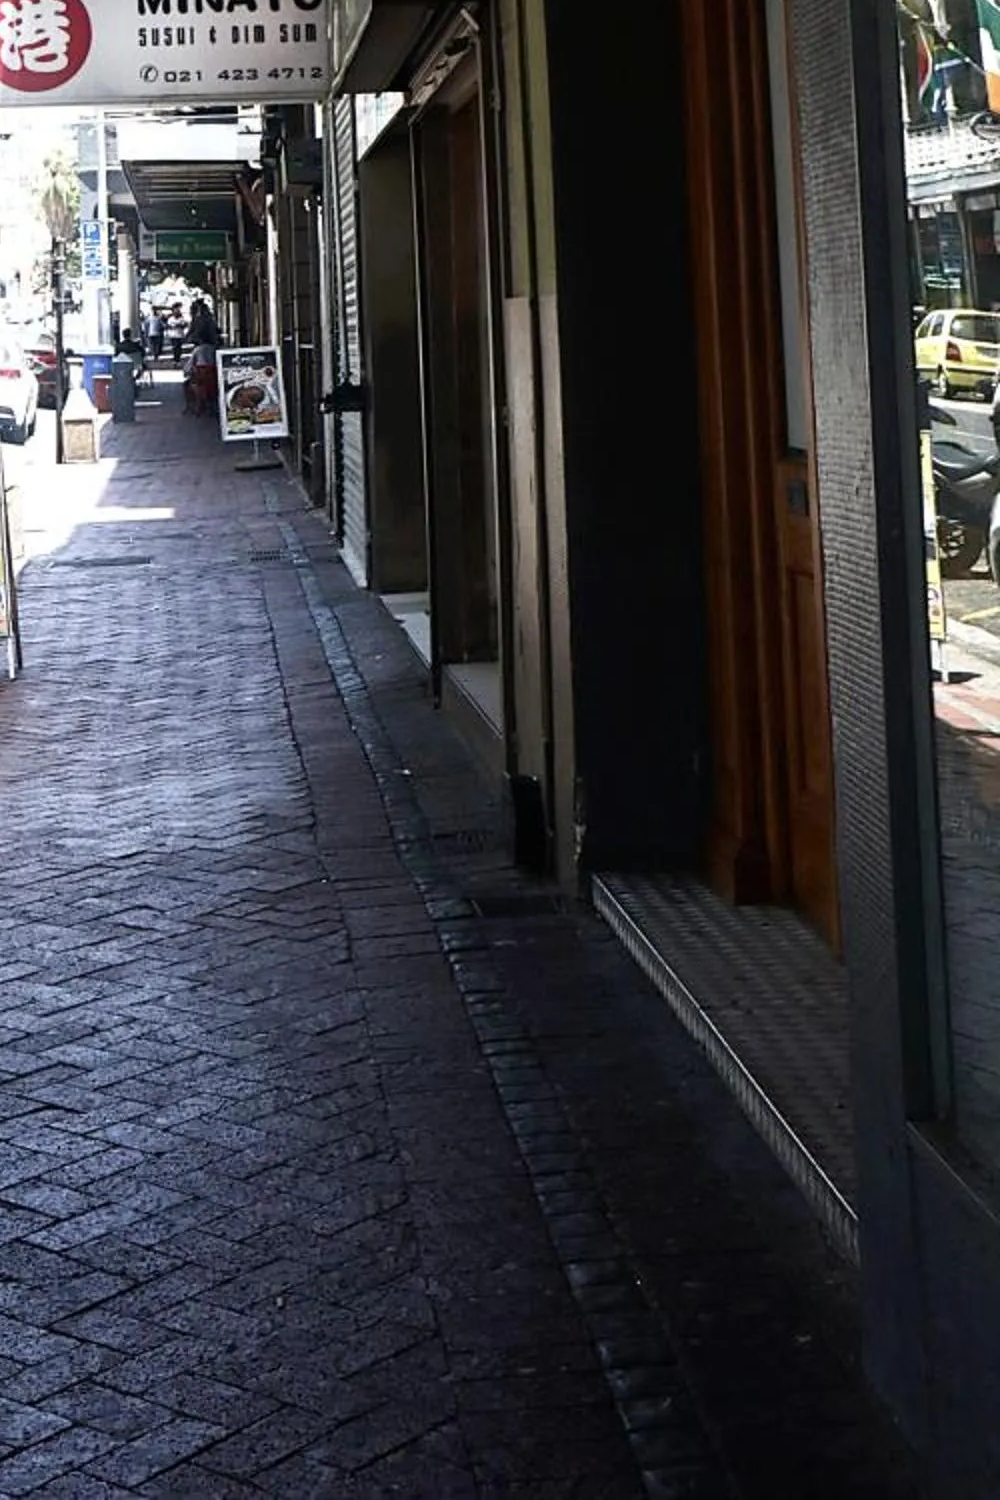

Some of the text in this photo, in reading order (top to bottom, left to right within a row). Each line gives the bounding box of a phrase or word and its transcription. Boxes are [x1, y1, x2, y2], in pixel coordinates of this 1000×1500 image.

[138, 25, 195, 47] SUSHI
[231, 24, 265, 44] DIM
[279, 23, 318, 43] SUM
[164, 66, 324, 83] 021 423 4712
